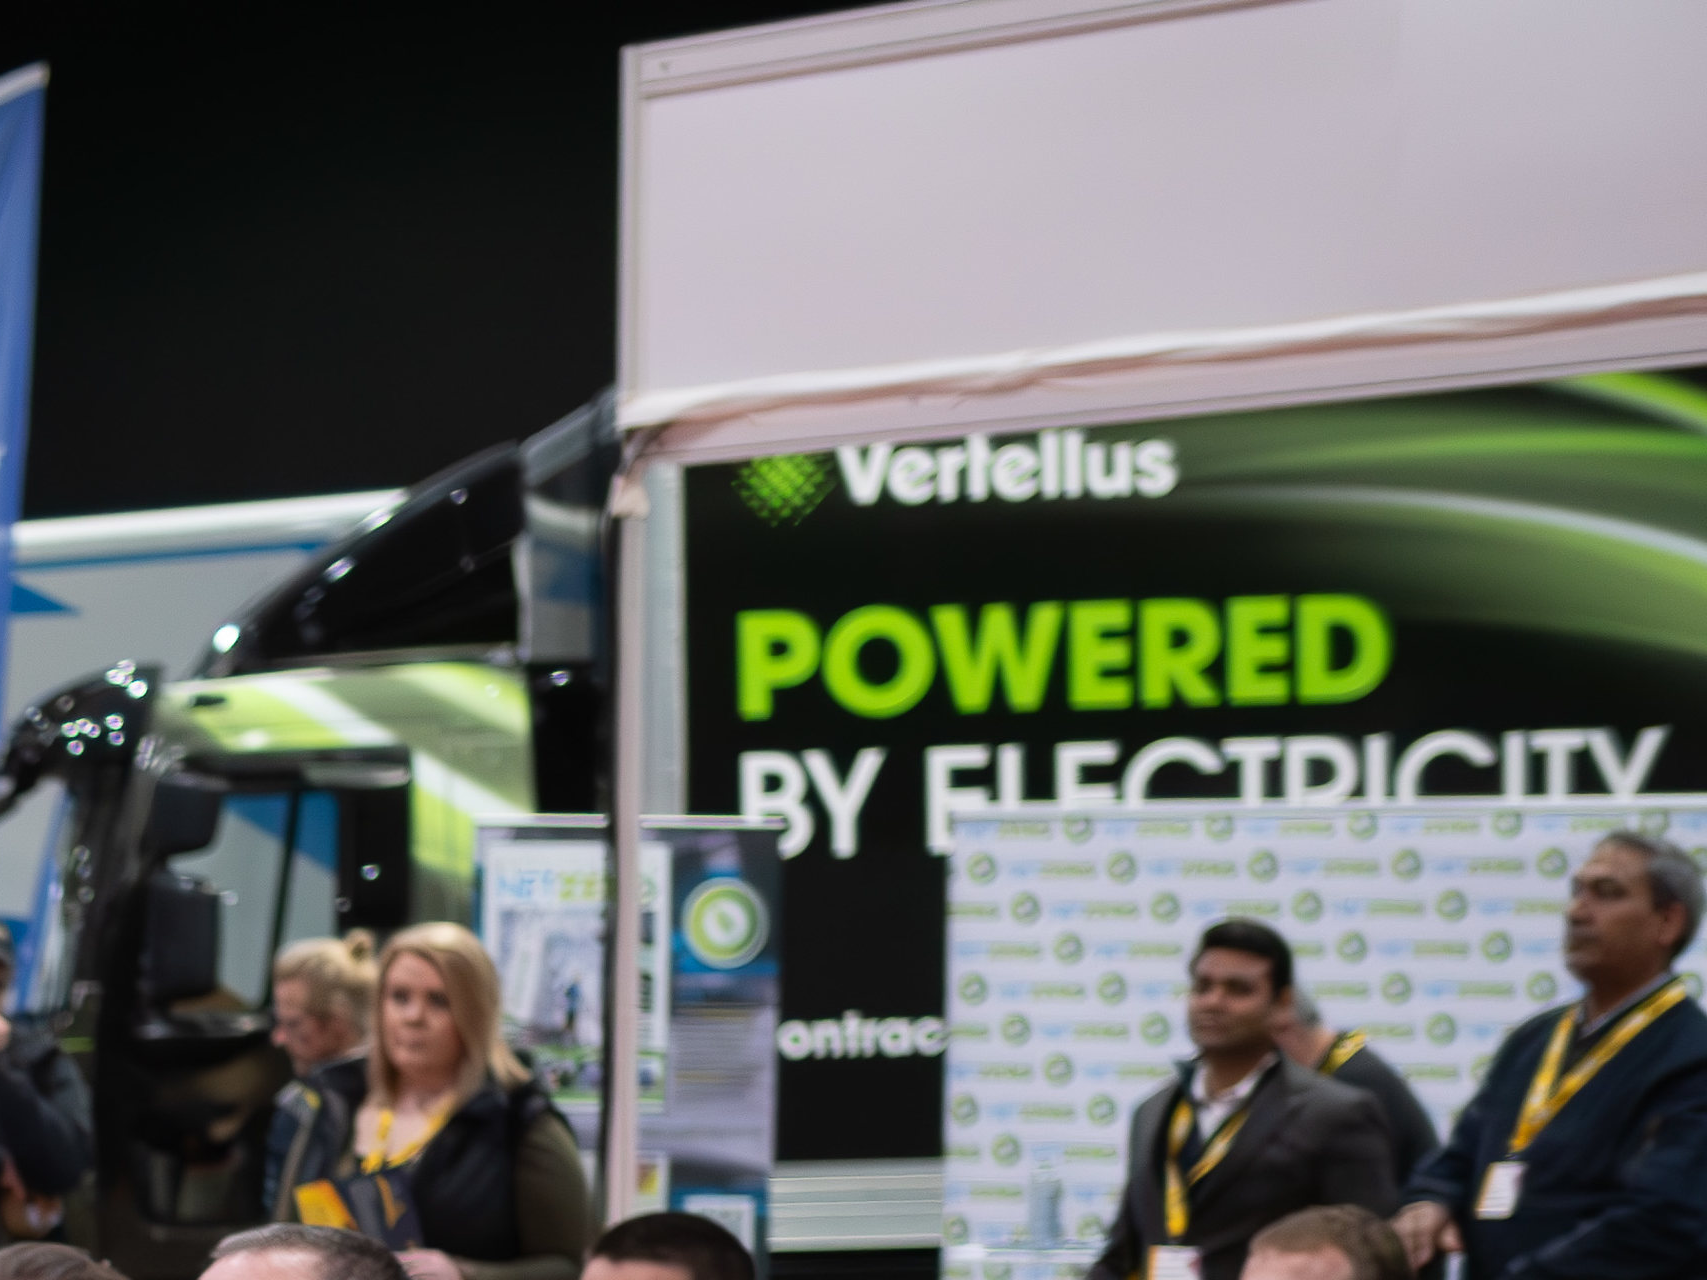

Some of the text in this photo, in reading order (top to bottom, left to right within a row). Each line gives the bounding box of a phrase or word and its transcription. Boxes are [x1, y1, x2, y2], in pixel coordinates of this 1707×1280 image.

[735, 594, 1390, 721] POWERED
[737, 746, 887, 860] BY
[777, 1009, 949, 1060] ontrac
